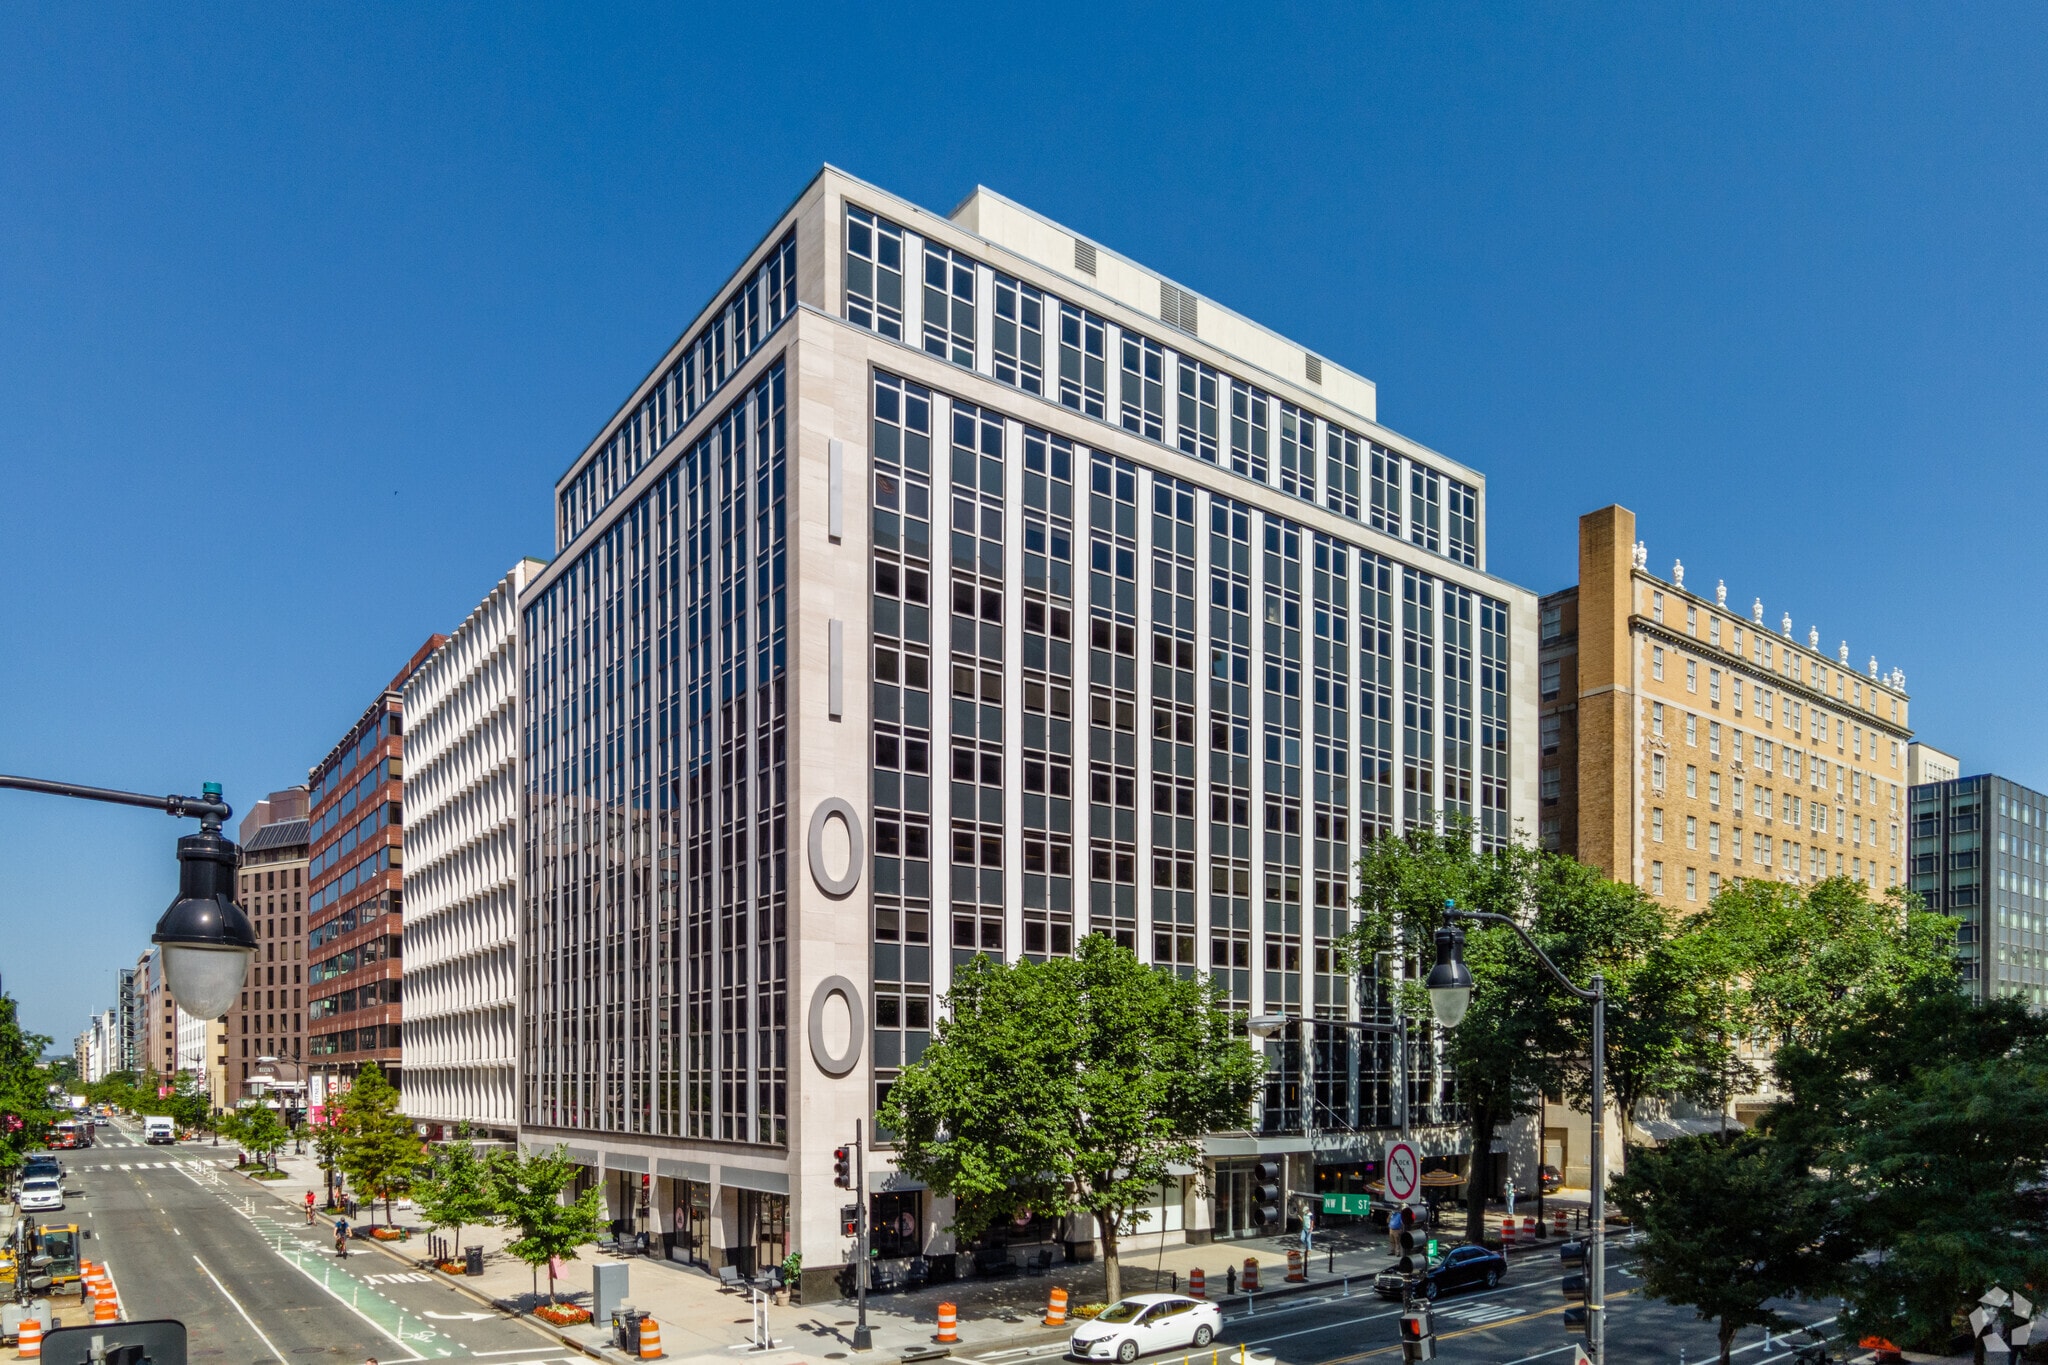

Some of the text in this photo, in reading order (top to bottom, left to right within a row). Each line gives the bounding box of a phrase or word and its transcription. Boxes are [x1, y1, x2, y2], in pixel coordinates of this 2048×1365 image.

[807, 438, 864, 1075] 1100
[1325, 1196, 1368, 1212] NW L ST
[363, 1272, 433, 1285] ONLY
